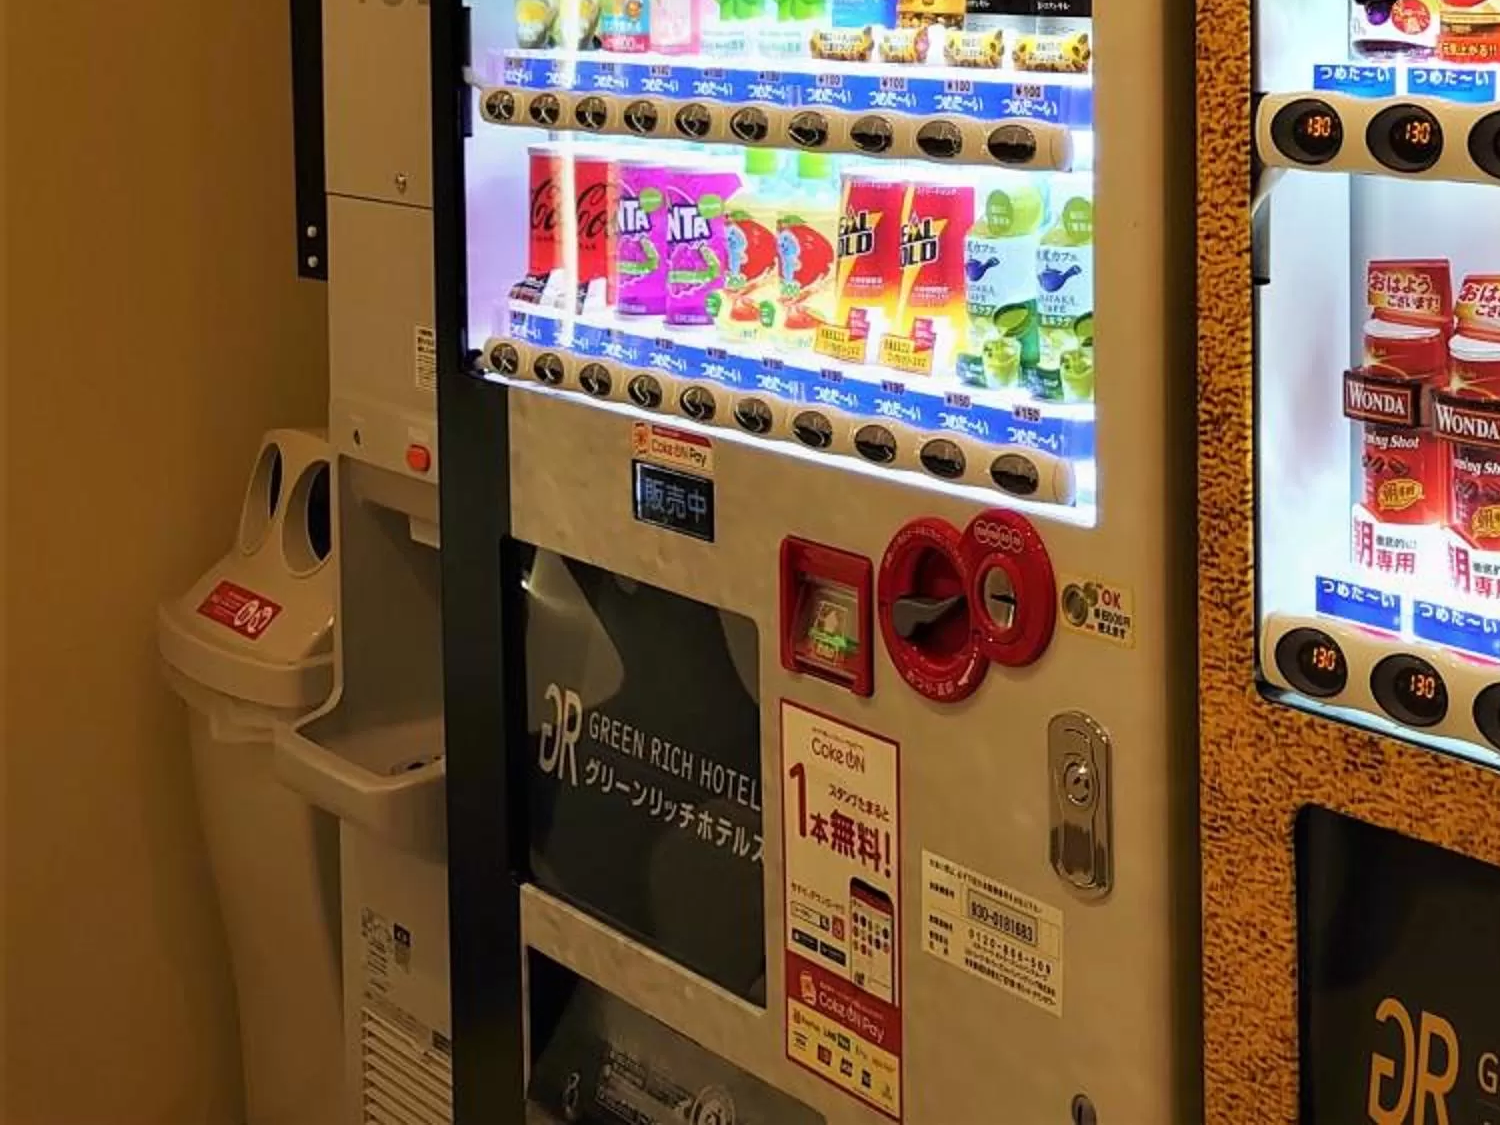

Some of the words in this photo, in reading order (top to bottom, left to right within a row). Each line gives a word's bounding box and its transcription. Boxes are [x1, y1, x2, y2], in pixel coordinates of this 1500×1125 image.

[1307, 115, 1331, 137] 130
[1405, 122, 1431, 144] 130
[1369, 271, 1432, 296] おはよう
[1348, 381, 1406, 417] WONDA
[1434, 401, 1500, 441] WONDA
[645, 477, 707, 524] 販売中
[1101, 588, 1122, 611] OK
[1313, 646, 1336, 671] 130
[1410, 673, 1435, 700] 130
[589, 710, 646, 760] GREEN
[651, 737, 695, 781] RICH
[700, 761, 762, 813] HOTEL
[811, 736, 844, 765] Coke
